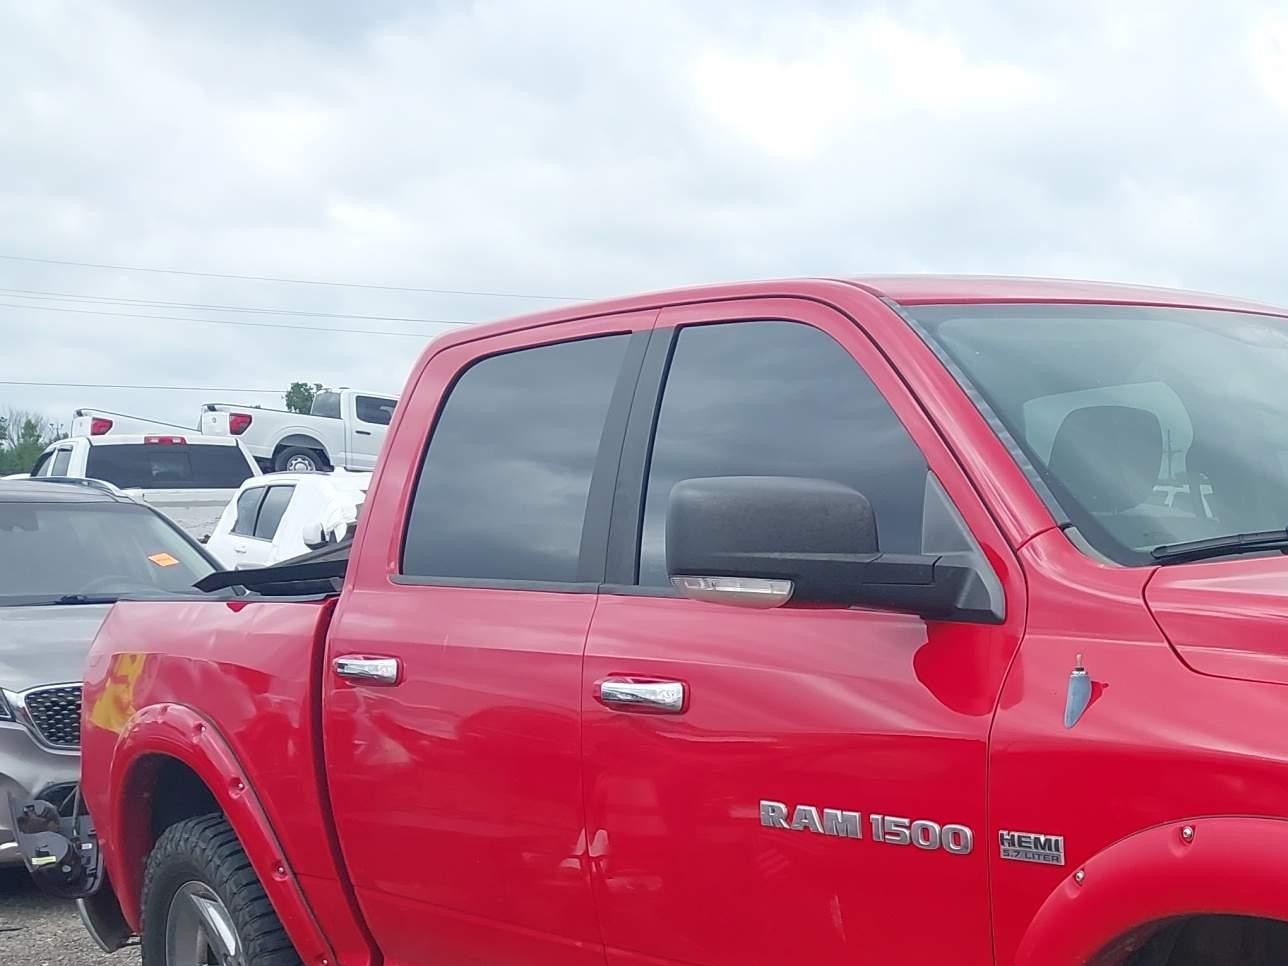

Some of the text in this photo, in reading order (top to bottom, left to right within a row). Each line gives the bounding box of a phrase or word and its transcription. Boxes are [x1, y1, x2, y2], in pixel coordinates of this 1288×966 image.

[760, 800, 974, 854] RAM 1500
[999, 831, 1061, 852] HEMI
[1002, 849, 1060, 864] 5.7 LITER
